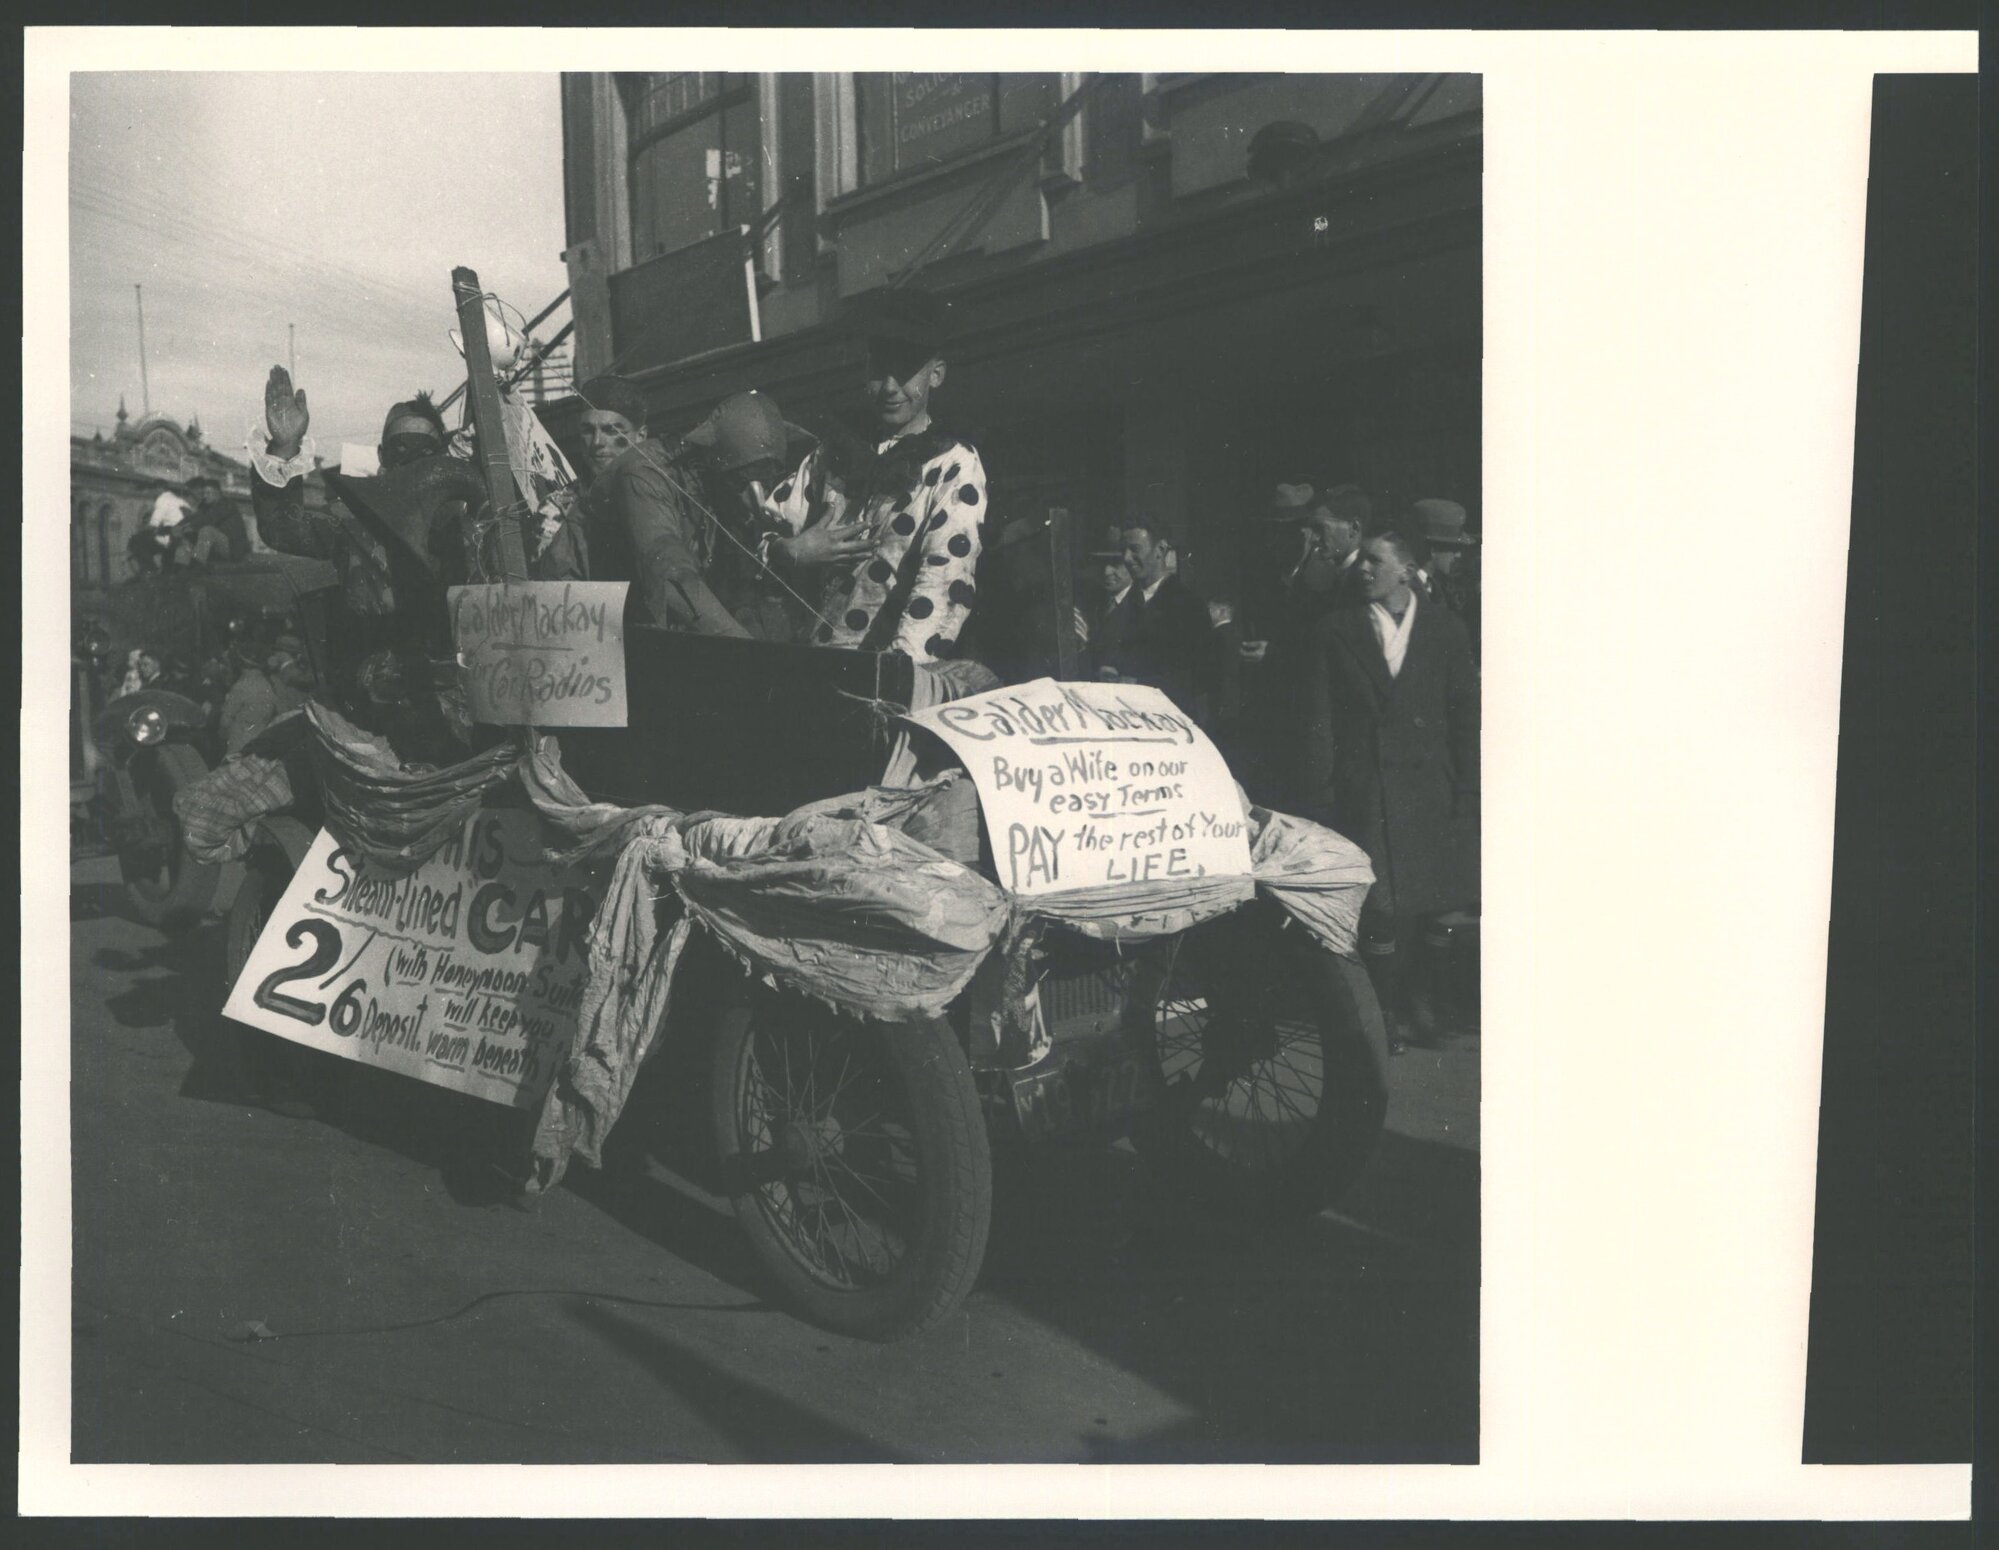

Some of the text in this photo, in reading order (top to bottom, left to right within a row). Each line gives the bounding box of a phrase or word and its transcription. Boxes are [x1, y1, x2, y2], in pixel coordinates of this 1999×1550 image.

[455, 583, 606, 643] Calder Mackay
[519, 656, 613, 704] Radios
[937, 687, 1194, 744] Calder Mackay
[993, 750, 1189, 803] Buy a Wife on our
[1049, 783, 1184, 815] easy Terms
[1008, 811, 1245, 888] PAY the rest of Your
[467, 883, 597, 965] CAR
[384, 945, 428, 988] (with
[430, 950, 527, 999] Honeymoon
[444, 996, 555, 1038] will keep you
[425, 1029, 470, 1065] warm
[472, 1035, 540, 1081] beneath
